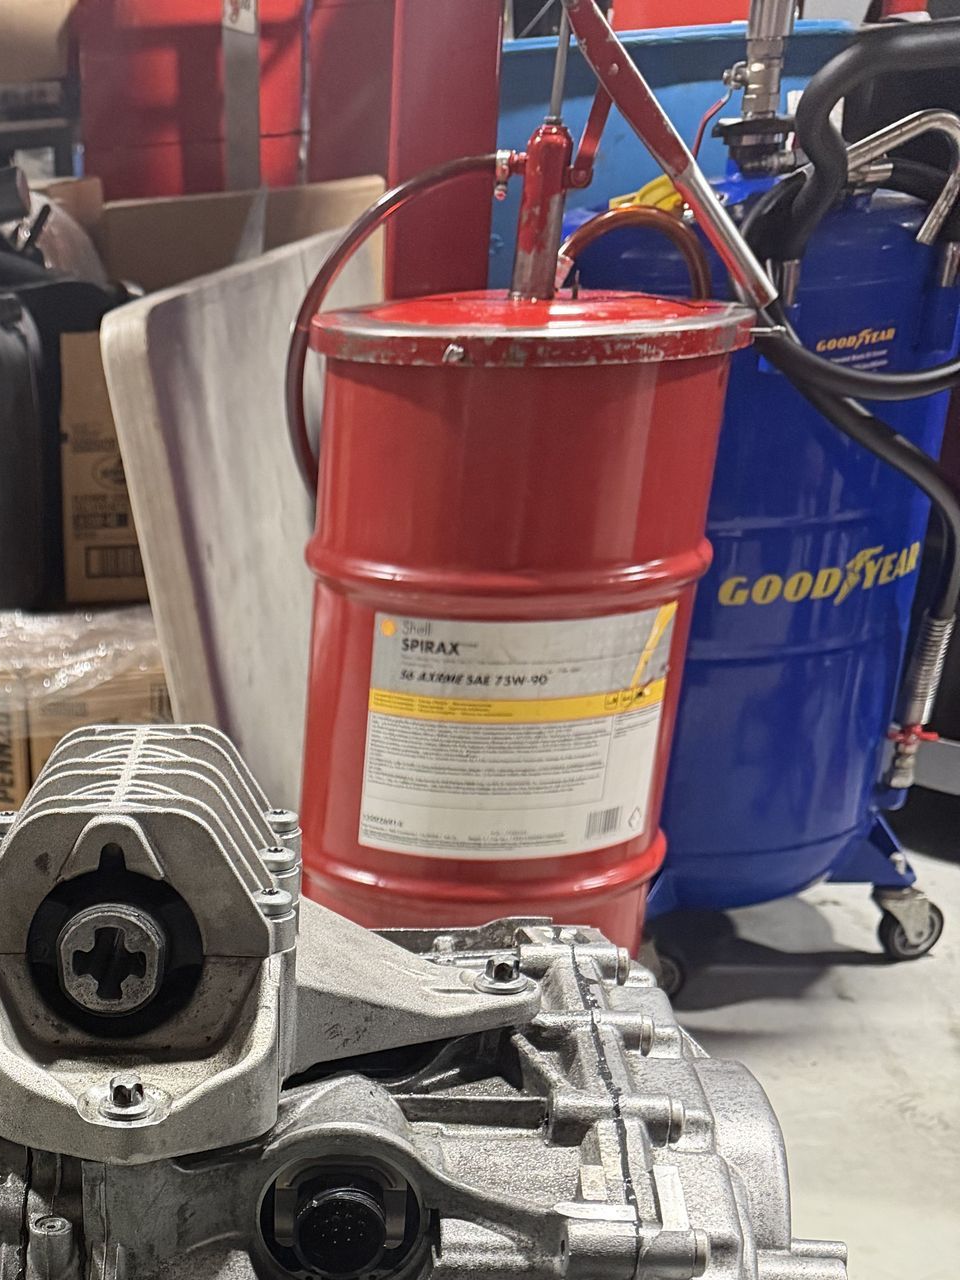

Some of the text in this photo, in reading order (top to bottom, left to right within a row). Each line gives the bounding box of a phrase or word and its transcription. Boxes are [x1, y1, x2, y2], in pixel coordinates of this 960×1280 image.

[816, 327, 896, 352] GOODYEAR
[401, 620, 431, 637] Shell
[401, 638, 460, 656] SPIRAX
[466, 674, 491, 687] SAE
